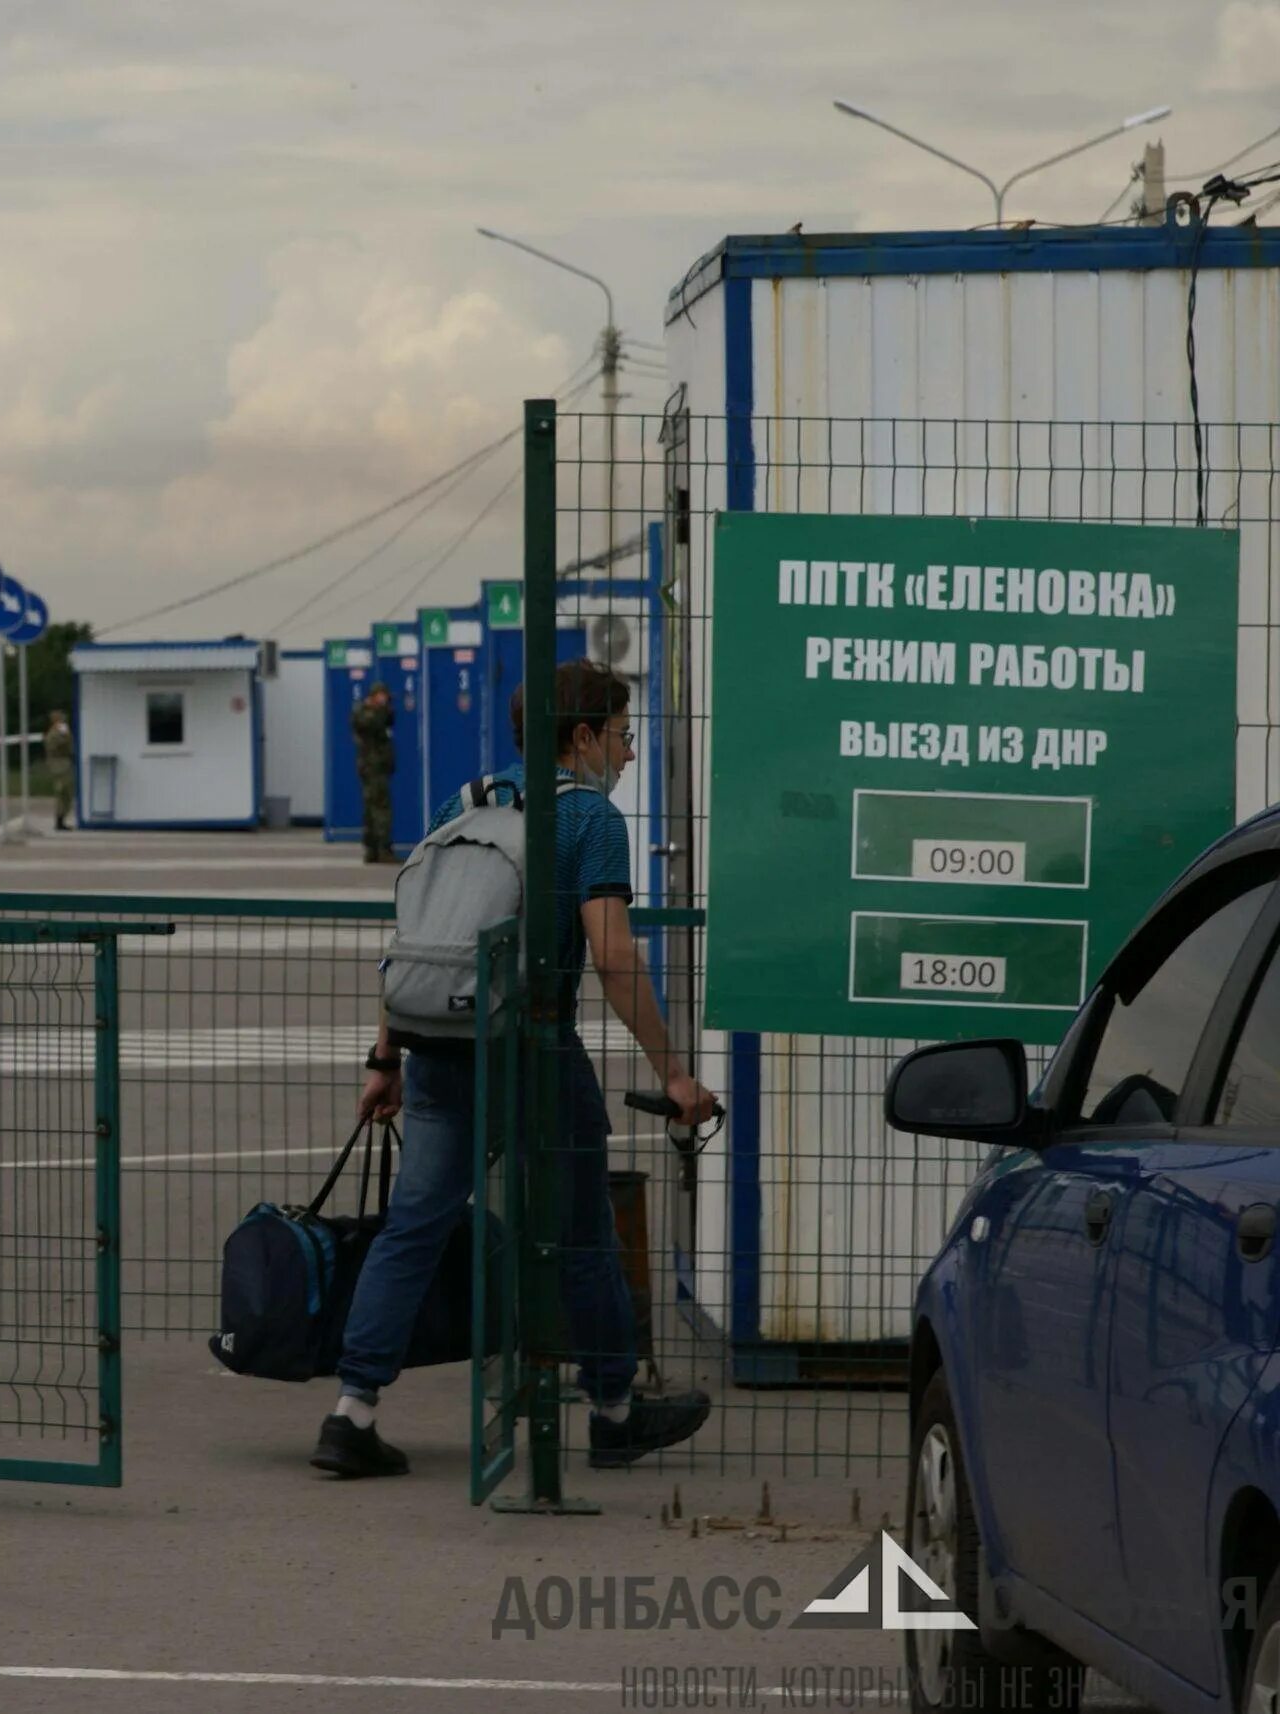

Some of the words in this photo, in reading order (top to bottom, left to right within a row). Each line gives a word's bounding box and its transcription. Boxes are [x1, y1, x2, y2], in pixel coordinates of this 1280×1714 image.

[778, 559, 895, 608] ППТК
[904, 565, 1176, 619] «ЕЛЕНОВКА»
[499, 594, 512, 615] 4
[459, 669, 469, 690] 3
[805, 636, 956, 685] РЕЖИМ
[969, 643, 1145, 693] РАБОТЫ
[839, 720, 970, 767] ВЫЕЗД
[978, 725, 1024, 763] ИЗ
[1031, 727, 1108, 770] ДНР
[929, 847, 1015, 876] 09:00
[913, 958, 996, 988] 18:00
